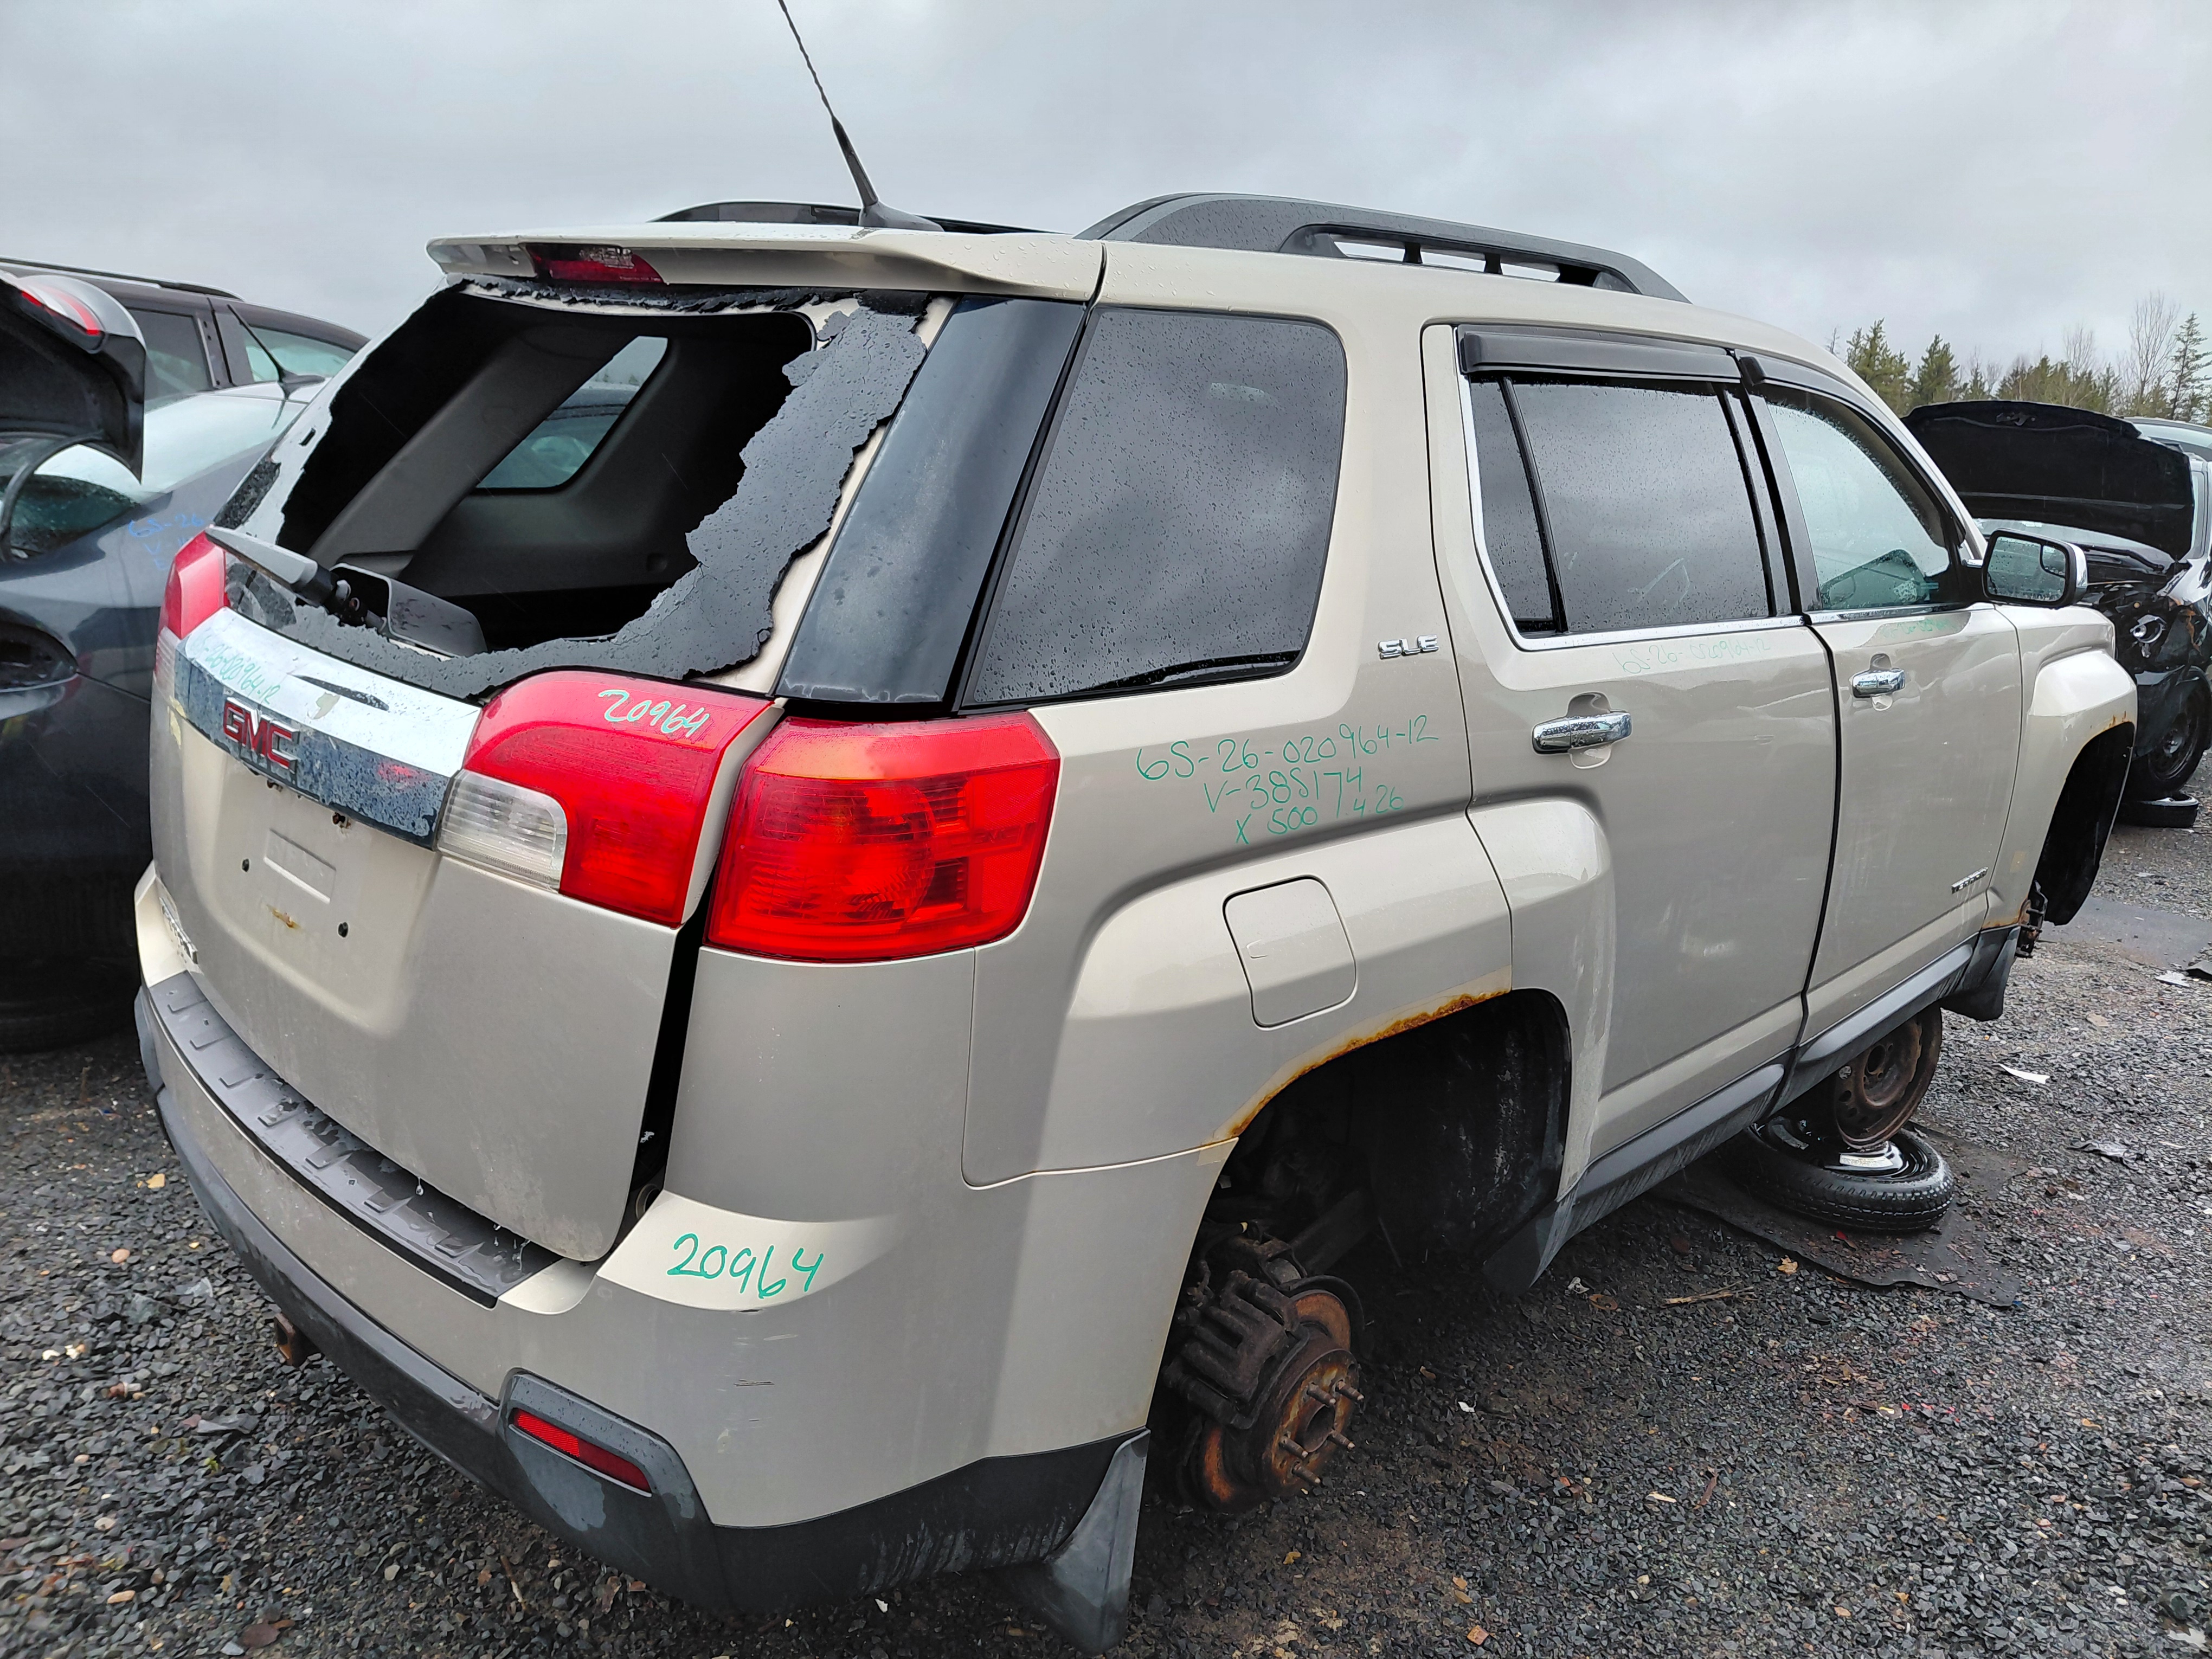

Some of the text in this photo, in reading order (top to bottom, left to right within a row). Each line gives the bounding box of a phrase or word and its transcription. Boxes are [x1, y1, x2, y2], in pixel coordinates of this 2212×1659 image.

[1378, 634, 1439, 660] SLE
[223, 697, 300, 774] GMC
[598, 689, 710, 738] 20964
[1267, 806, 1318, 834] 500
[667, 1233, 824, 1300] 20964
